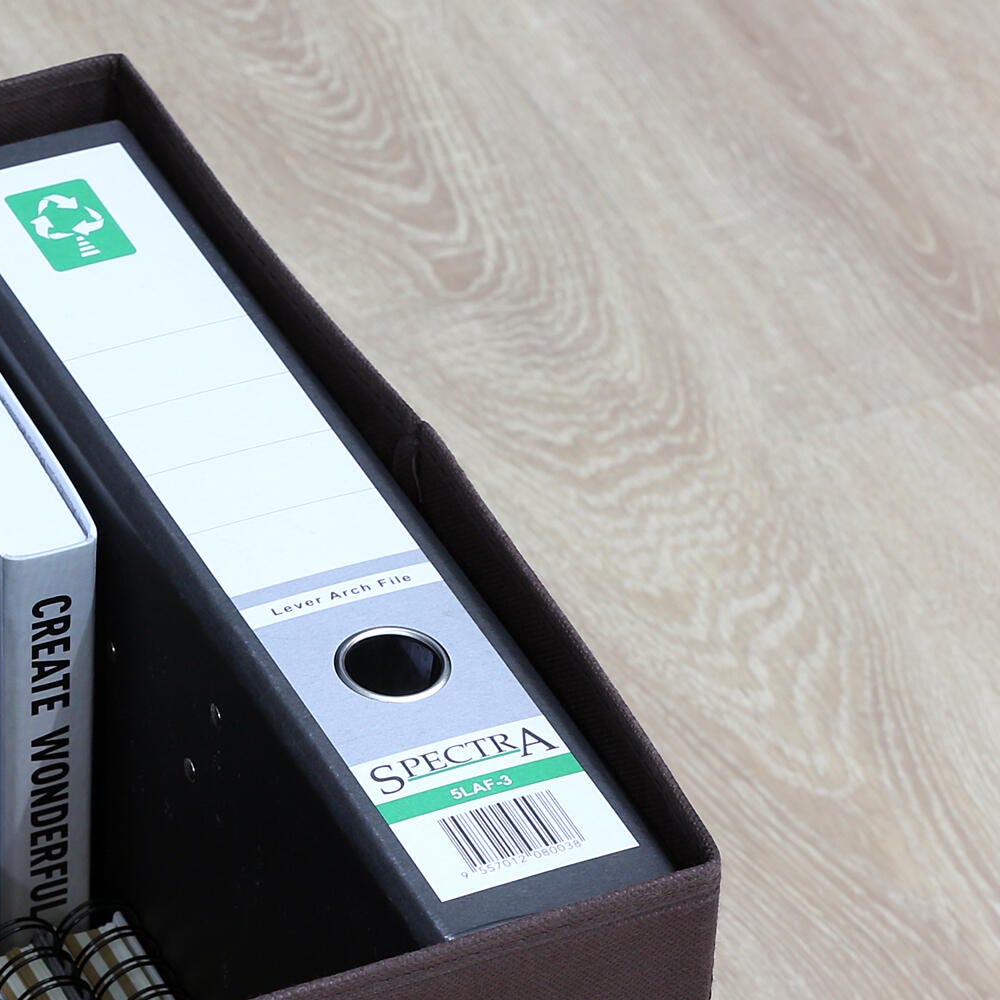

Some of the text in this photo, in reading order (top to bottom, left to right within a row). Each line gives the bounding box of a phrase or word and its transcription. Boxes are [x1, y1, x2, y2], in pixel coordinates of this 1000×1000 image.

[270, 572, 413, 617] Lever Arch File
[29, 594, 73, 921] CREATE WONDERFUL
[369, 727, 560, 795] SPECTRA
[450, 774, 514, 801] 5LAF-3
